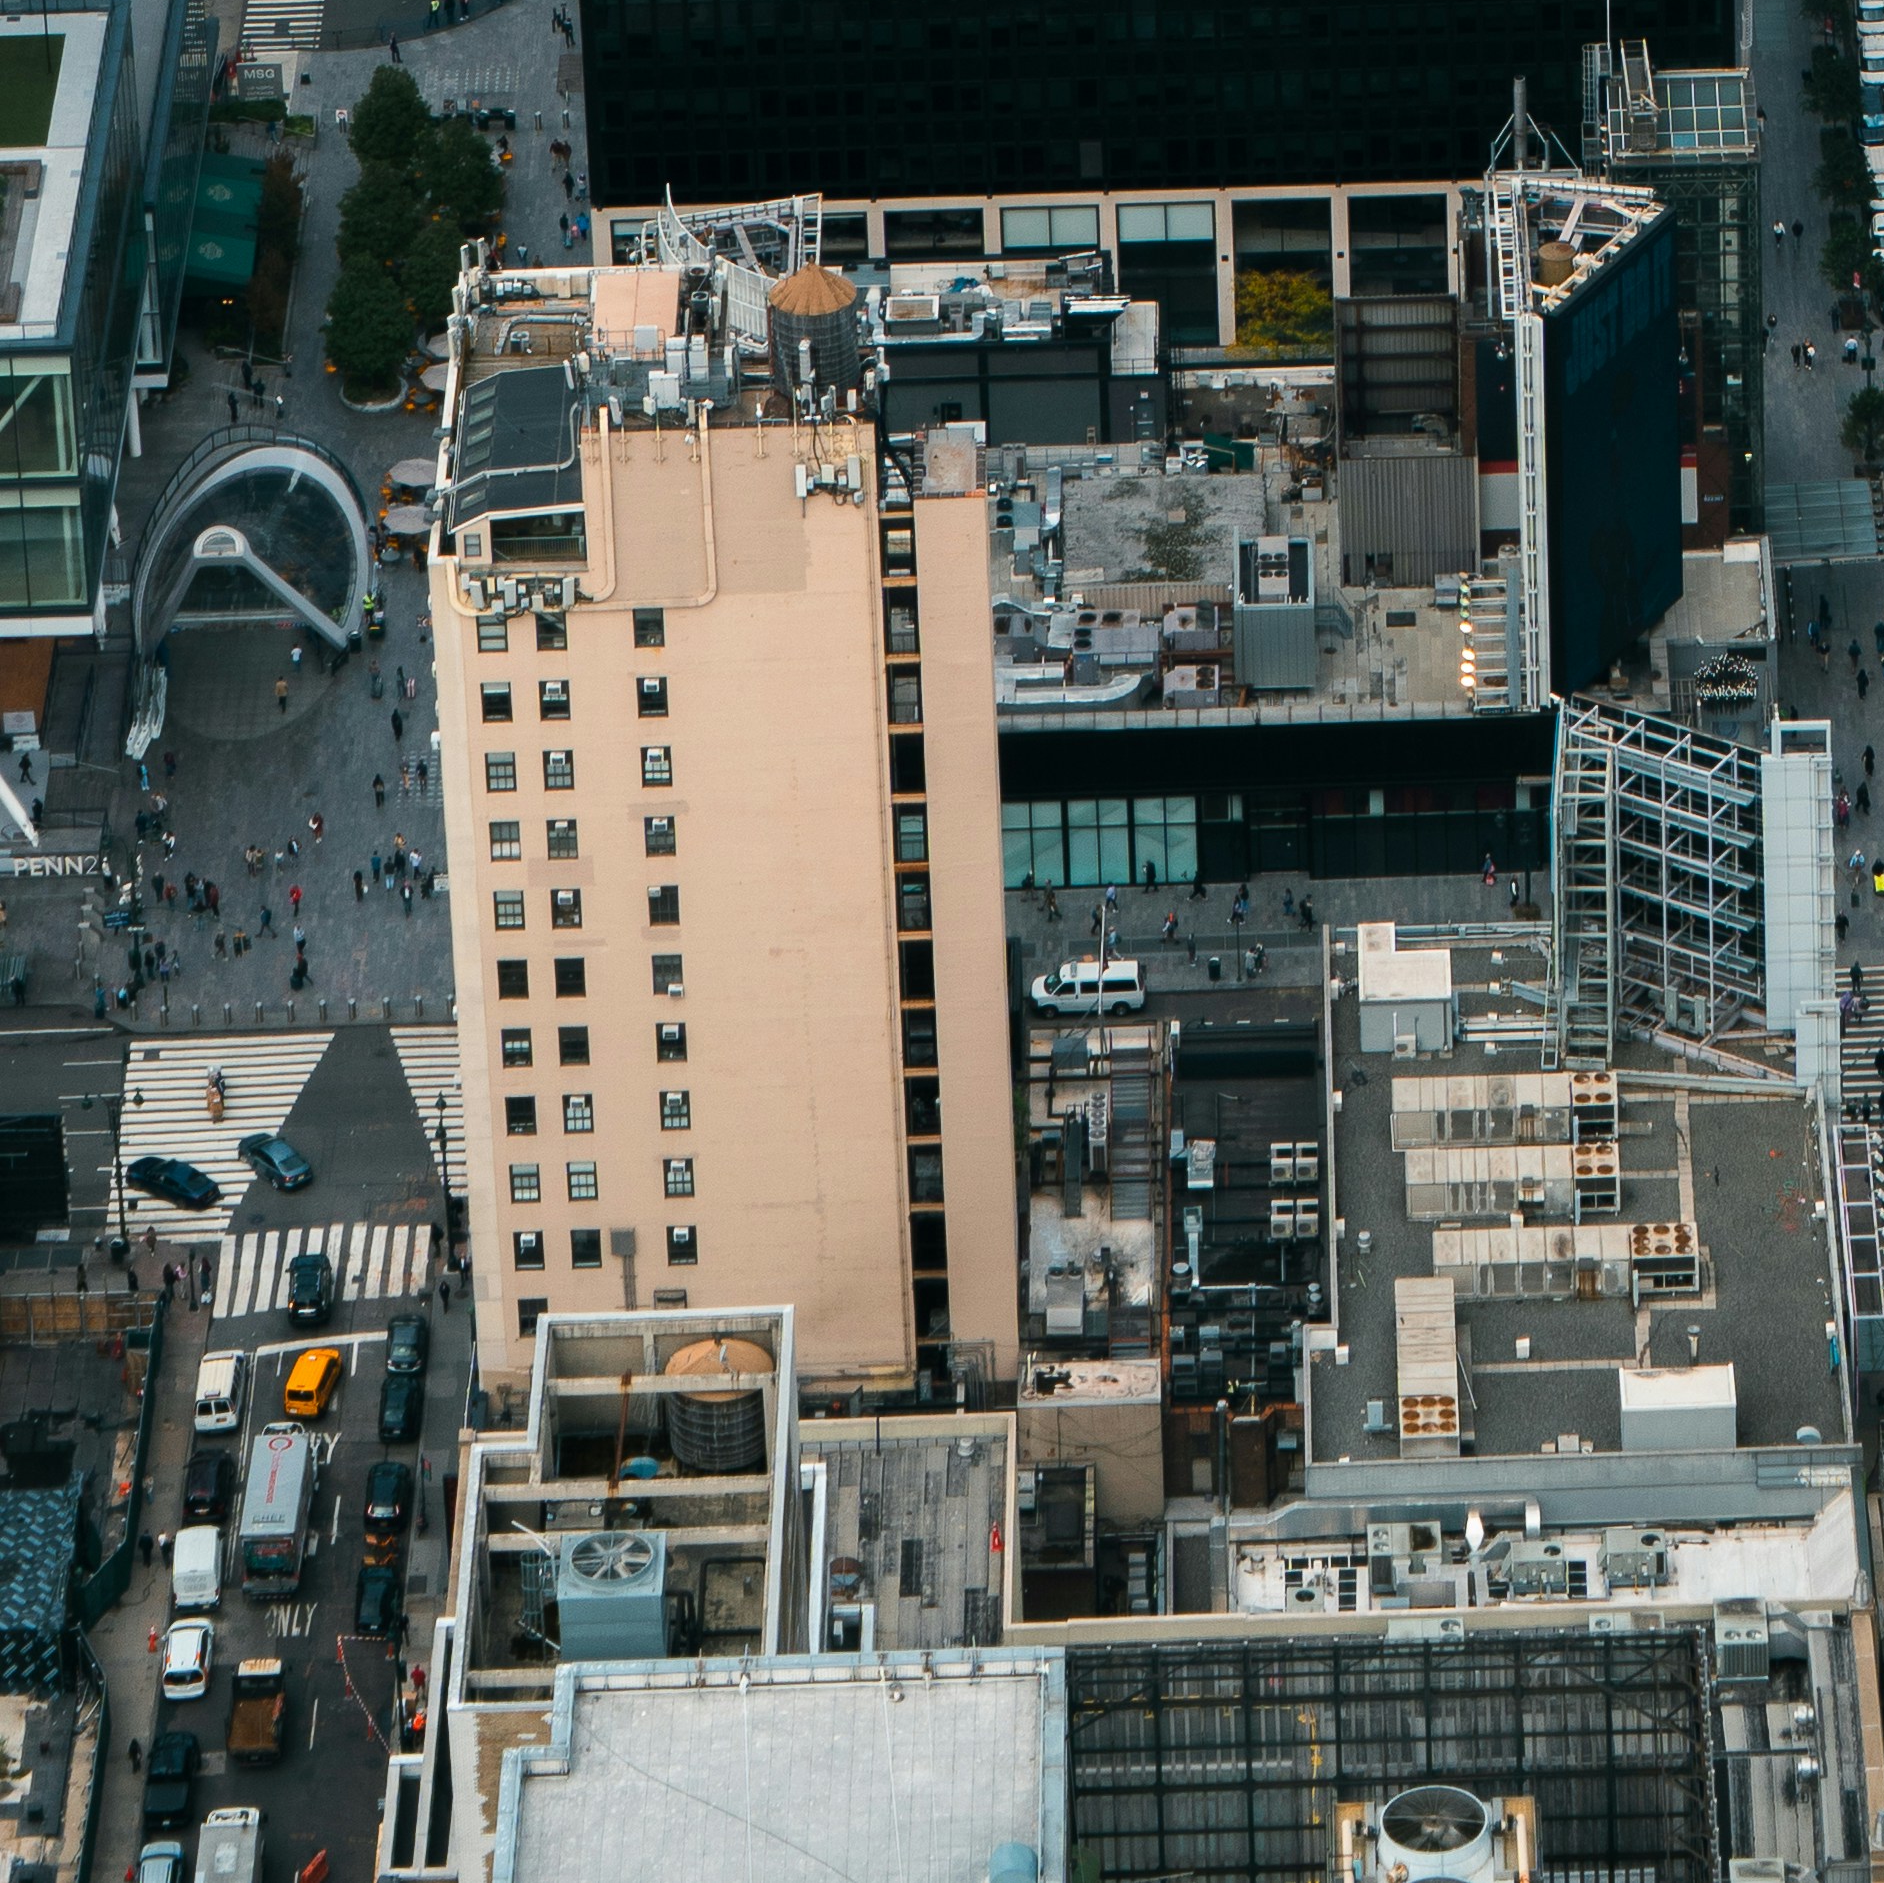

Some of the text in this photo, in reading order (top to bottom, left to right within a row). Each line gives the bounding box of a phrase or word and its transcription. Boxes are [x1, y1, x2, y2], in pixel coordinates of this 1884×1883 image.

[244, 69, 275, 80] MSG
[1566, 278, 1619, 396] JUST
[14, 855, 99, 877] PENN2
[265, 1602, 319, 1638] ONLY
